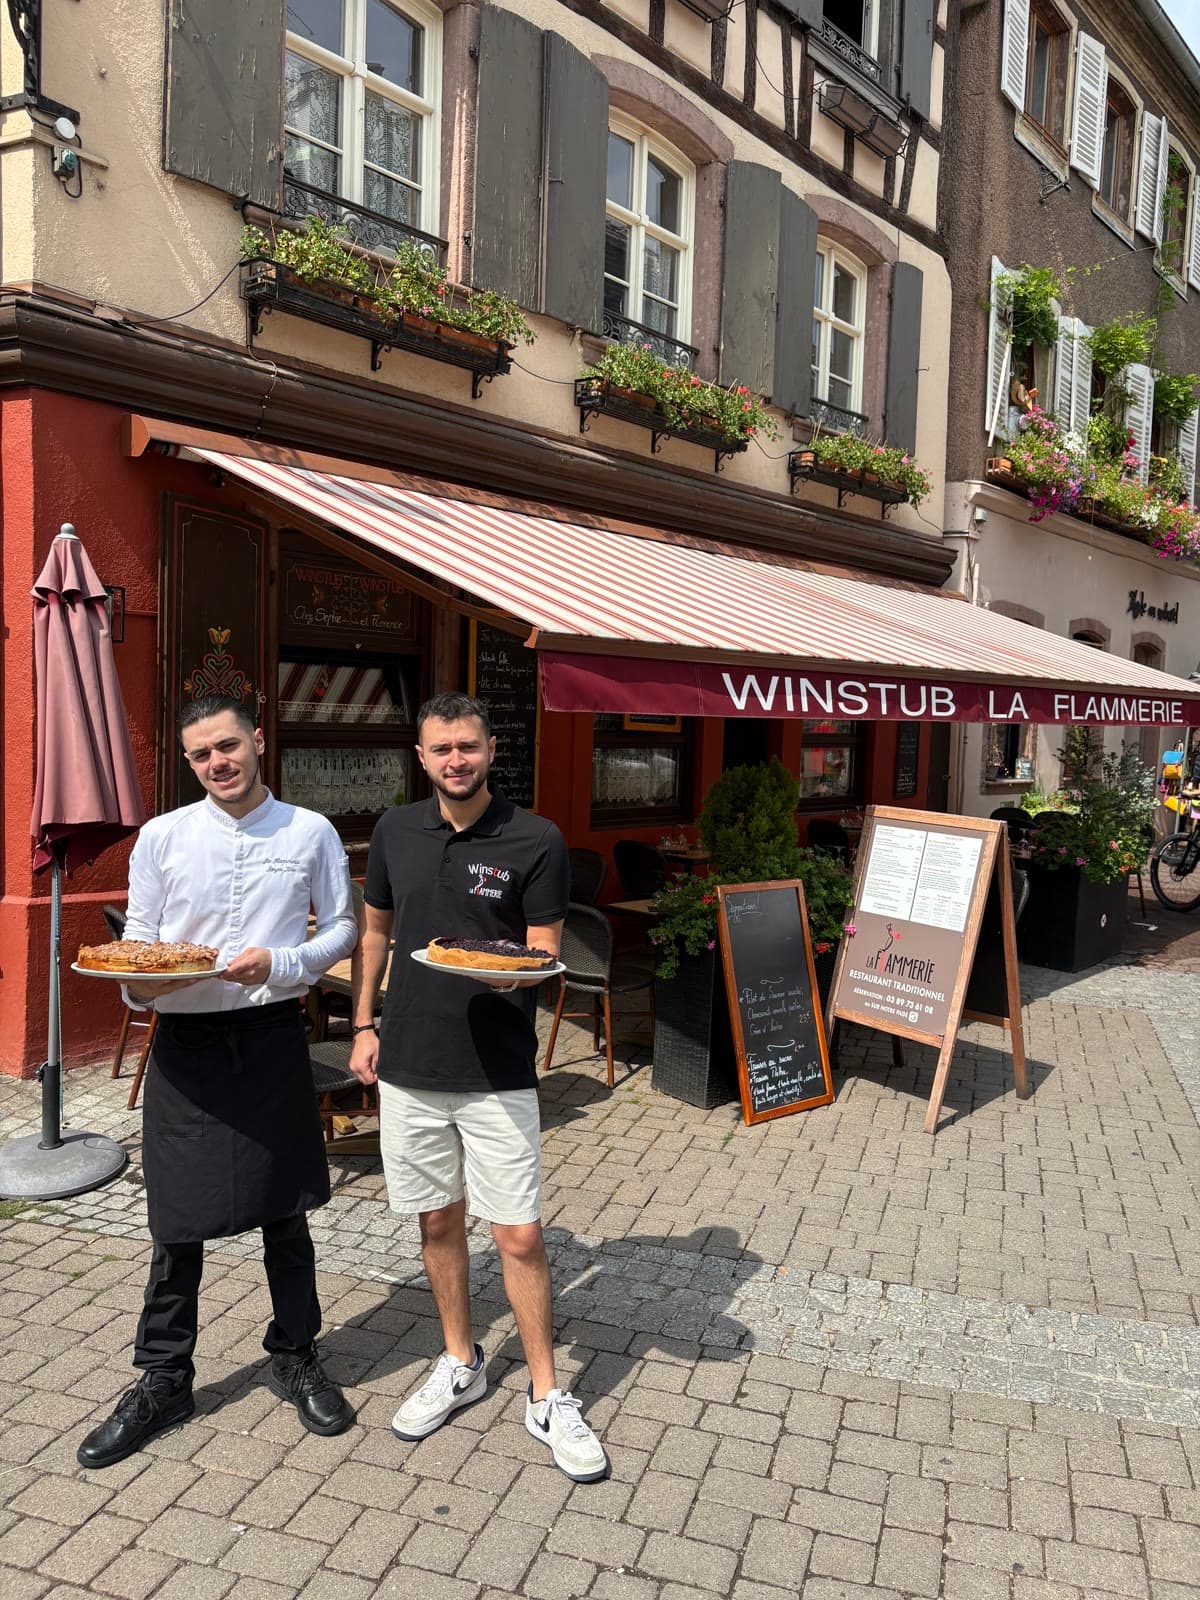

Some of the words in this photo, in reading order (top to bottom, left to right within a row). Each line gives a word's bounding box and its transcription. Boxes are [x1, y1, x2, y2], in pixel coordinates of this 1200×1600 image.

[296, 567, 344, 590] WINSTUB
[721, 672, 956, 717] WINSTUB
[988, 690, 1029, 719] LA
[1053, 694, 1183, 723] FLAMMERIE
[468, 863, 510, 882] Winstub
[866, 955, 874, 969] LA
[849, 968, 893, 988] RESTAURANT
[893, 980, 945, 1002] TRADITIONNEL
[886, 994, 895, 1004] 03
[905, 1000, 914, 1009] 73
[914, 1002, 923, 1011] 61
